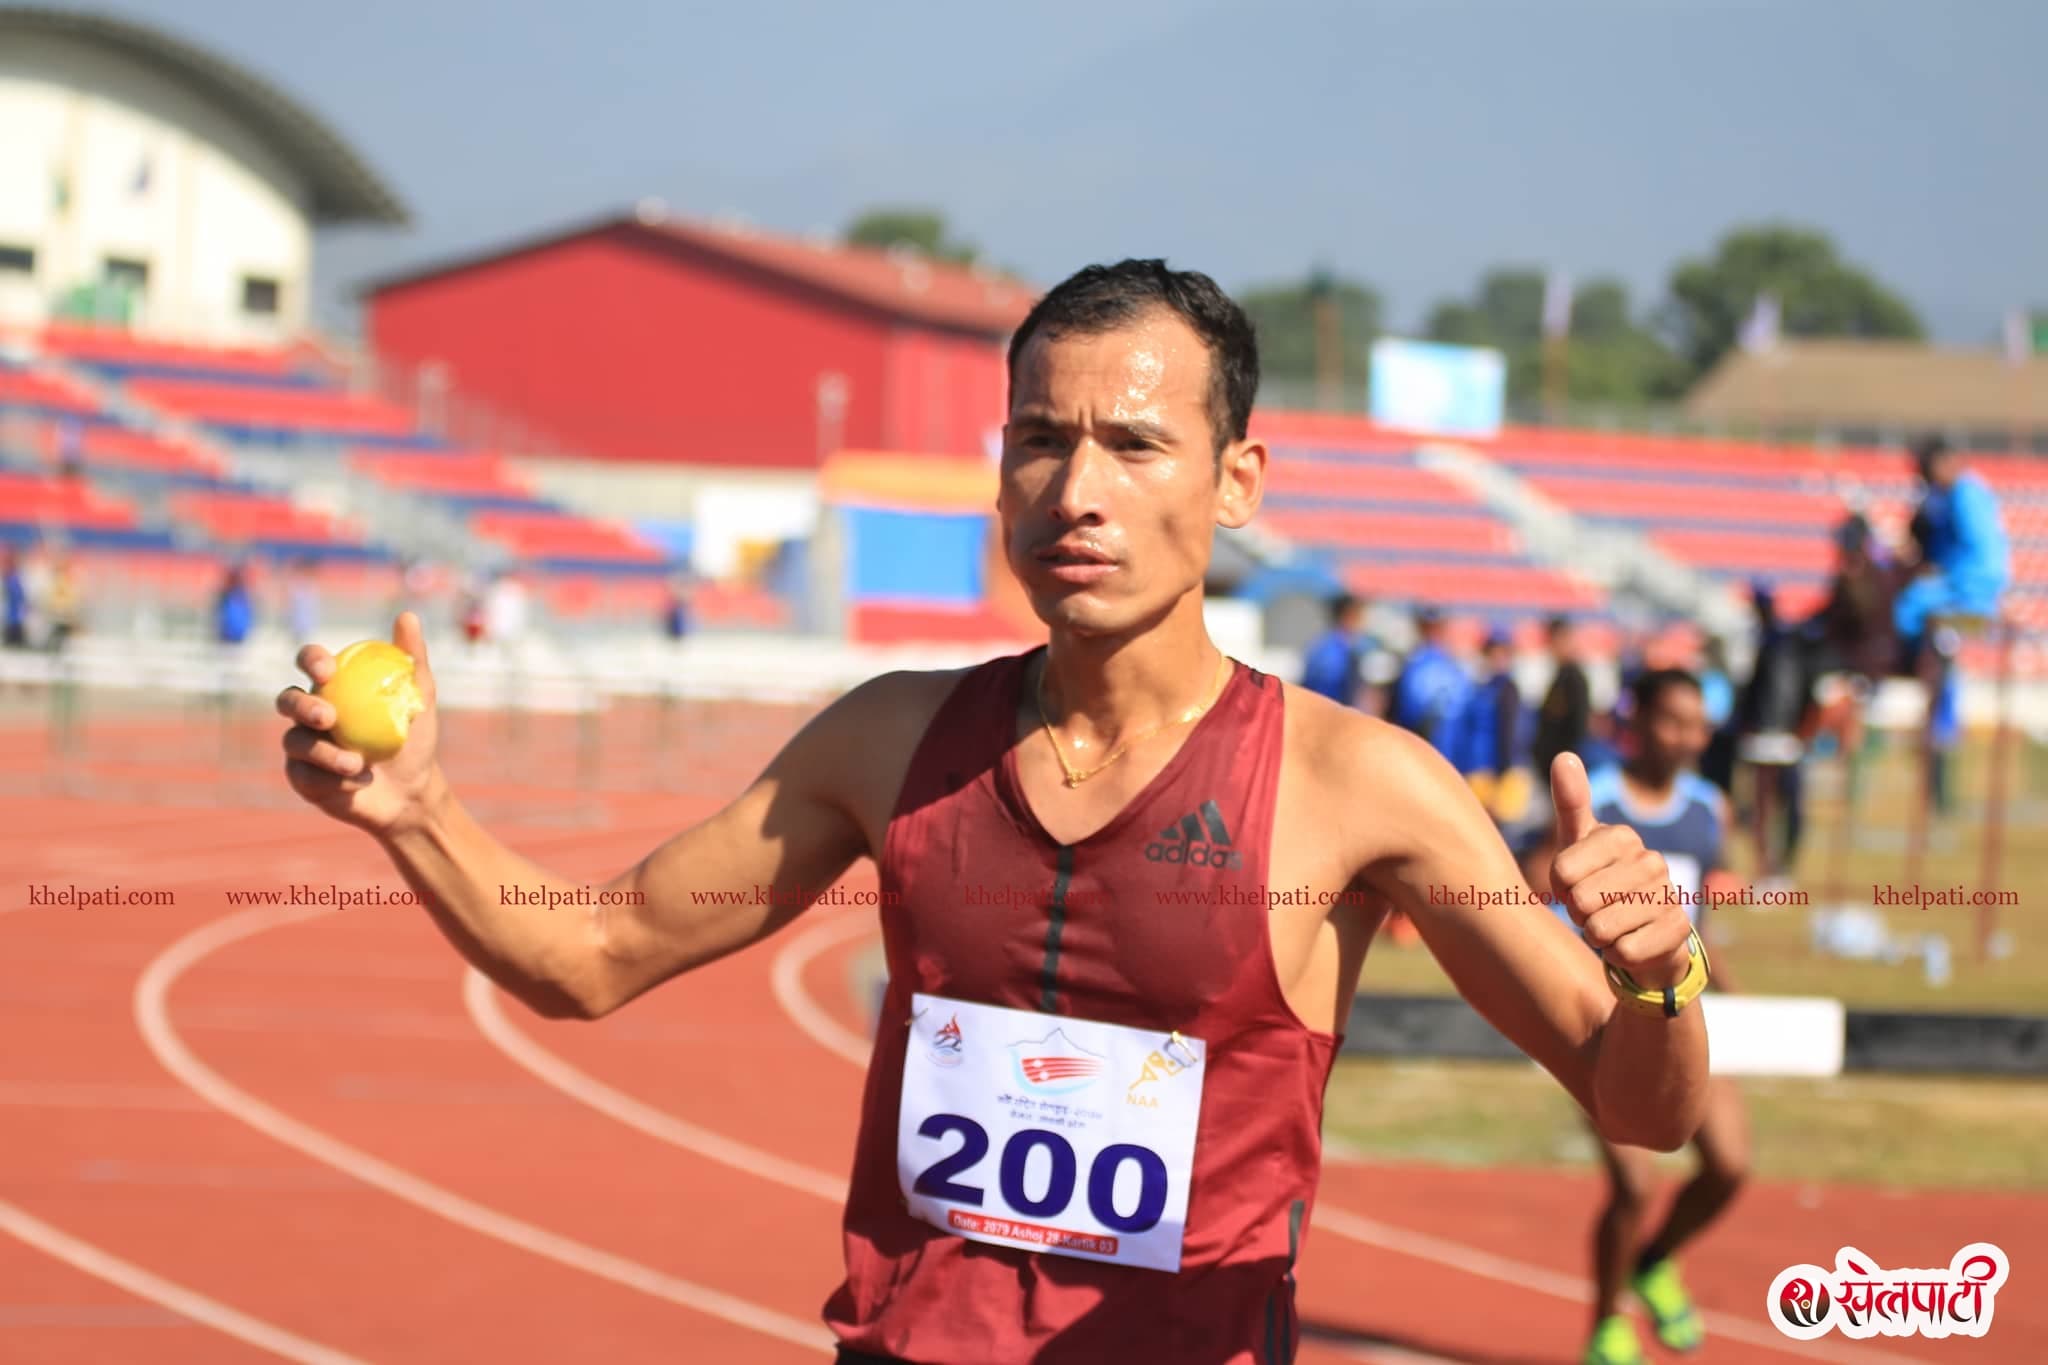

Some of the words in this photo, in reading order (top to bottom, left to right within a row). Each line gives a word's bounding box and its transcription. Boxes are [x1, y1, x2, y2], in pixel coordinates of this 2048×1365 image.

[1144, 838, 1243, 871] adidas
[1127, 1094, 1158, 1108] NAA
[913, 1113, 1168, 1234] 200
[953, 1215, 979, 1230] Date:
[983, 1221, 1010, 1236] 2079
[1011, 1227, 1043, 1244] Ashoj
